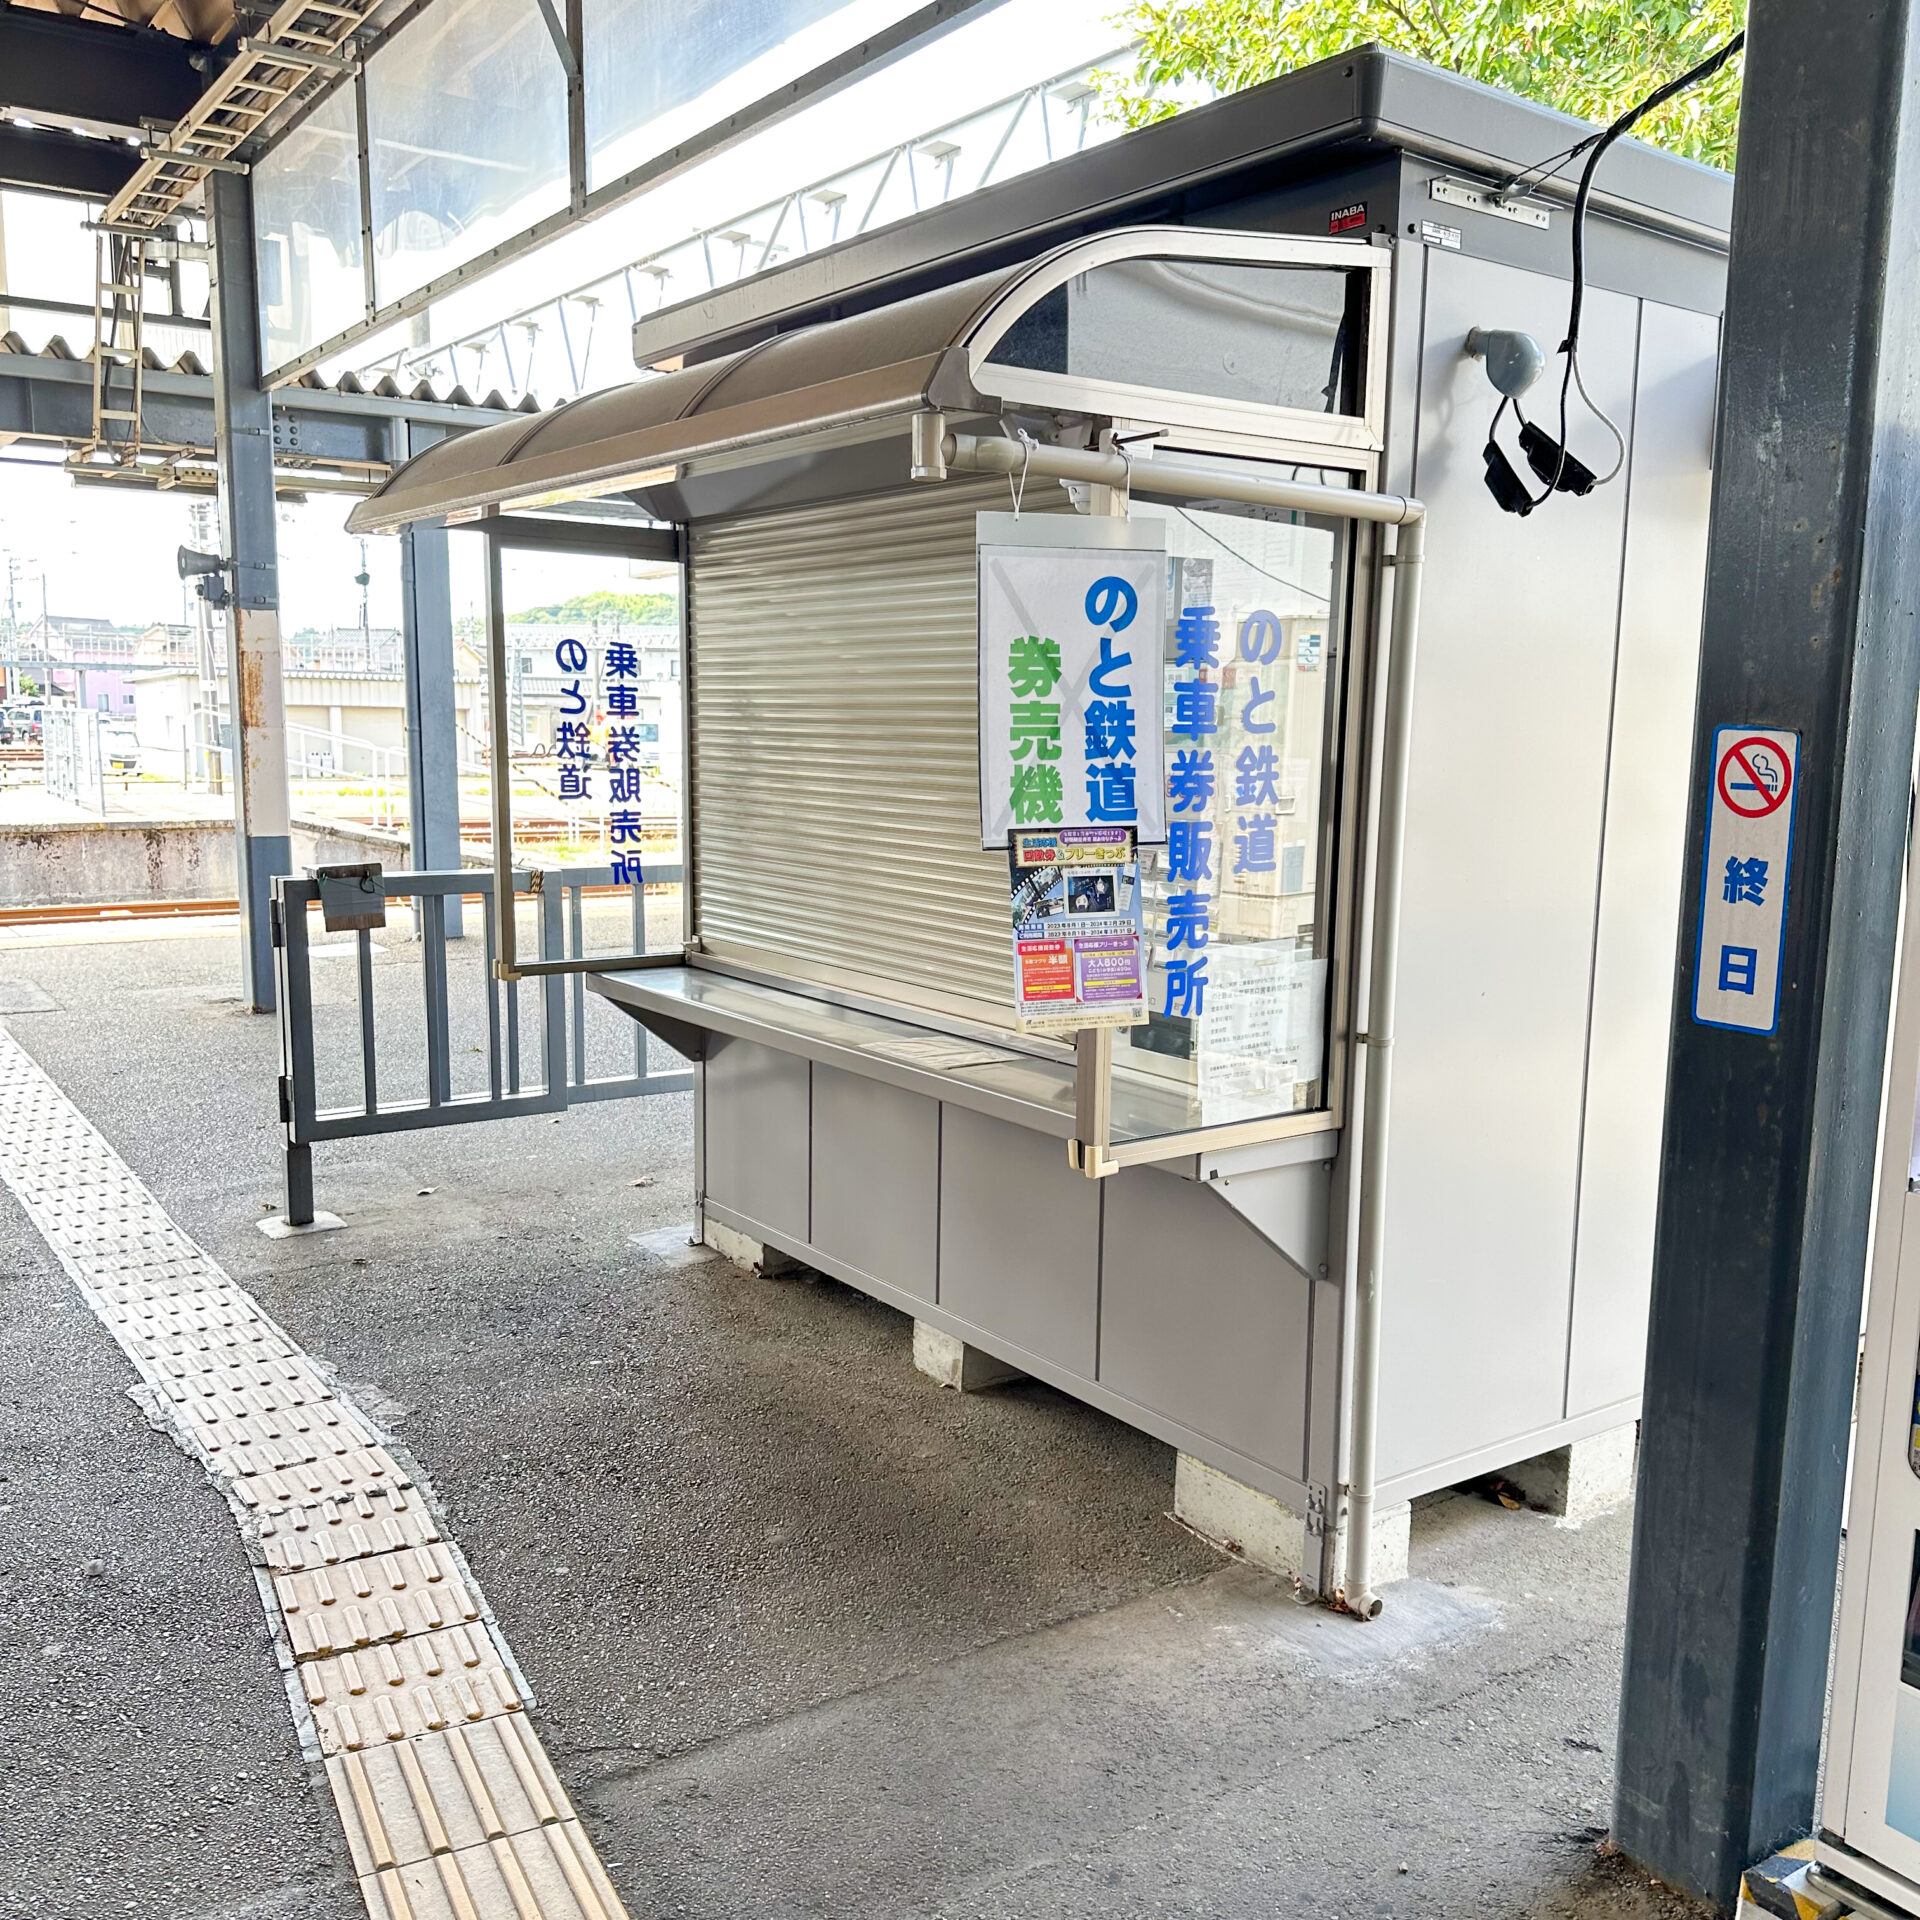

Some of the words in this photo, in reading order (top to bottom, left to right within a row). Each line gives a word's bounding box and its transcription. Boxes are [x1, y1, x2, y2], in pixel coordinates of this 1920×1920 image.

[1331, 204, 1365, 221] INABA
[1008, 635, 1063, 825] 券売機
[1084, 576, 1138, 823] のと鉄道
[1233, 609, 1283, 875] のと鉄道
[1163, 606, 1221, 1019] 乗車券販売所
[1718, 856, 1769, 995] 終日
